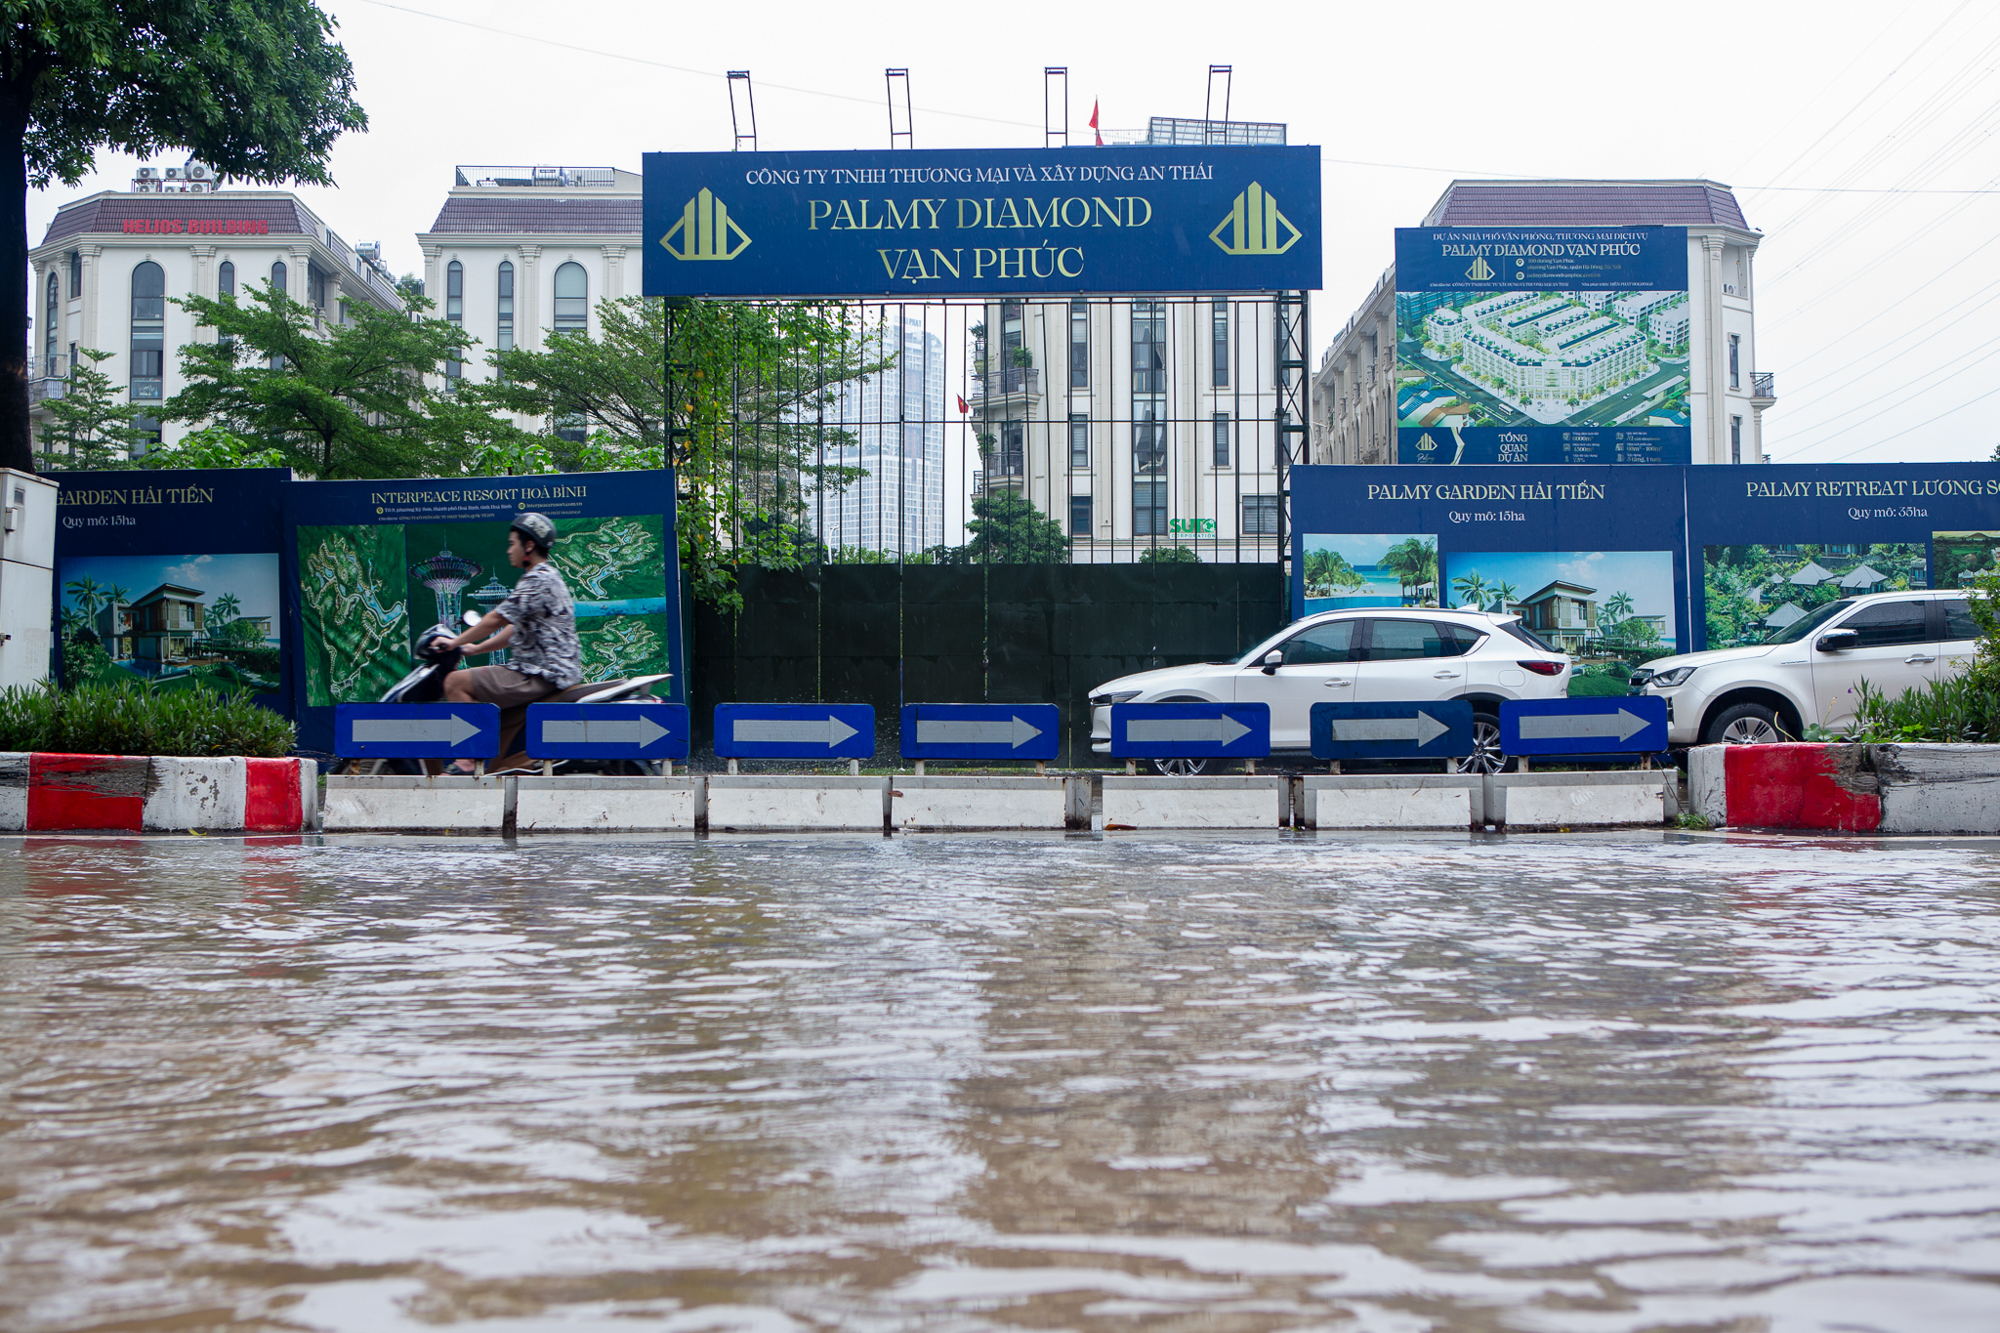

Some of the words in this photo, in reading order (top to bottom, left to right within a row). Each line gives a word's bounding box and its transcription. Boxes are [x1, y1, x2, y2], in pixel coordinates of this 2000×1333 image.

[746, 168, 800, 185] CÔNG
[804, 169, 828, 184] TY
[831, 169, 887, 184] TNHH
[890, 167, 972, 184] THƯƠNG
[976, 167, 1010, 184] MẠI
[1013, 163, 1037, 182] VÀ
[1040, 164, 1076, 182] XÂY
[1080, 165, 1135, 183] DỰNG
[1137, 165, 1165, 181] AN
[1169, 162, 1213, 180] THÁI
[807, 199, 947, 230] PALMY
[956, 196, 1152, 229] DIAMOND
[123, 219, 183, 234] HELIOS
[188, 219, 268, 234] BUILDING
[1442, 244, 1492, 257] PALMY
[1494, 243, 1565, 256] DIAMOND
[1566, 243, 1598, 258] VẠN
[1600, 241, 1641, 256] PHÚC
[876, 248, 964, 284] VẠN
[972, 239, 1084, 279] PHÚC
[1498, 431, 1528, 442] TỔNG
[1500, 443, 1528, 453] QUAN
[1498, 453, 1513, 463] DỰ
[1513, 452, 1528, 462] ÁN
[131, 486, 163, 504] HẢI
[166, 483, 214, 504] TIẾN
[371, 490, 461, 504] INTERPEACE
[463, 488, 519, 501] RESORT
[521, 484, 551, 499] HOÀ
[553, 484, 587, 498] BÌNH
[1367, 484, 1433, 500] PALMY
[1435, 484, 1516, 500] GARDEN
[1519, 481, 1553, 500] HẢI
[1556, 479, 1606, 500] TIẾN
[1746, 481, 1812, 497] PALMY
[1815, 480, 1908, 497] RETREAT
[1911, 478, 1983, 496] LƯƠNG
[1986, 479, 2000, 495] S
[1448, 510, 1472, 523] Quy
[1474, 511, 1497, 522] mô:
[1498, 510, 1526, 522] 15ha
[1848, 506, 1871, 520] Quy
[1874, 506, 1897, 517] mô:
[1898, 506, 1929, 518] 35ha
[62, 516, 85, 529] Quy
[87, 516, 109, 526] mô:
[111, 515, 137, 526] 15ha
